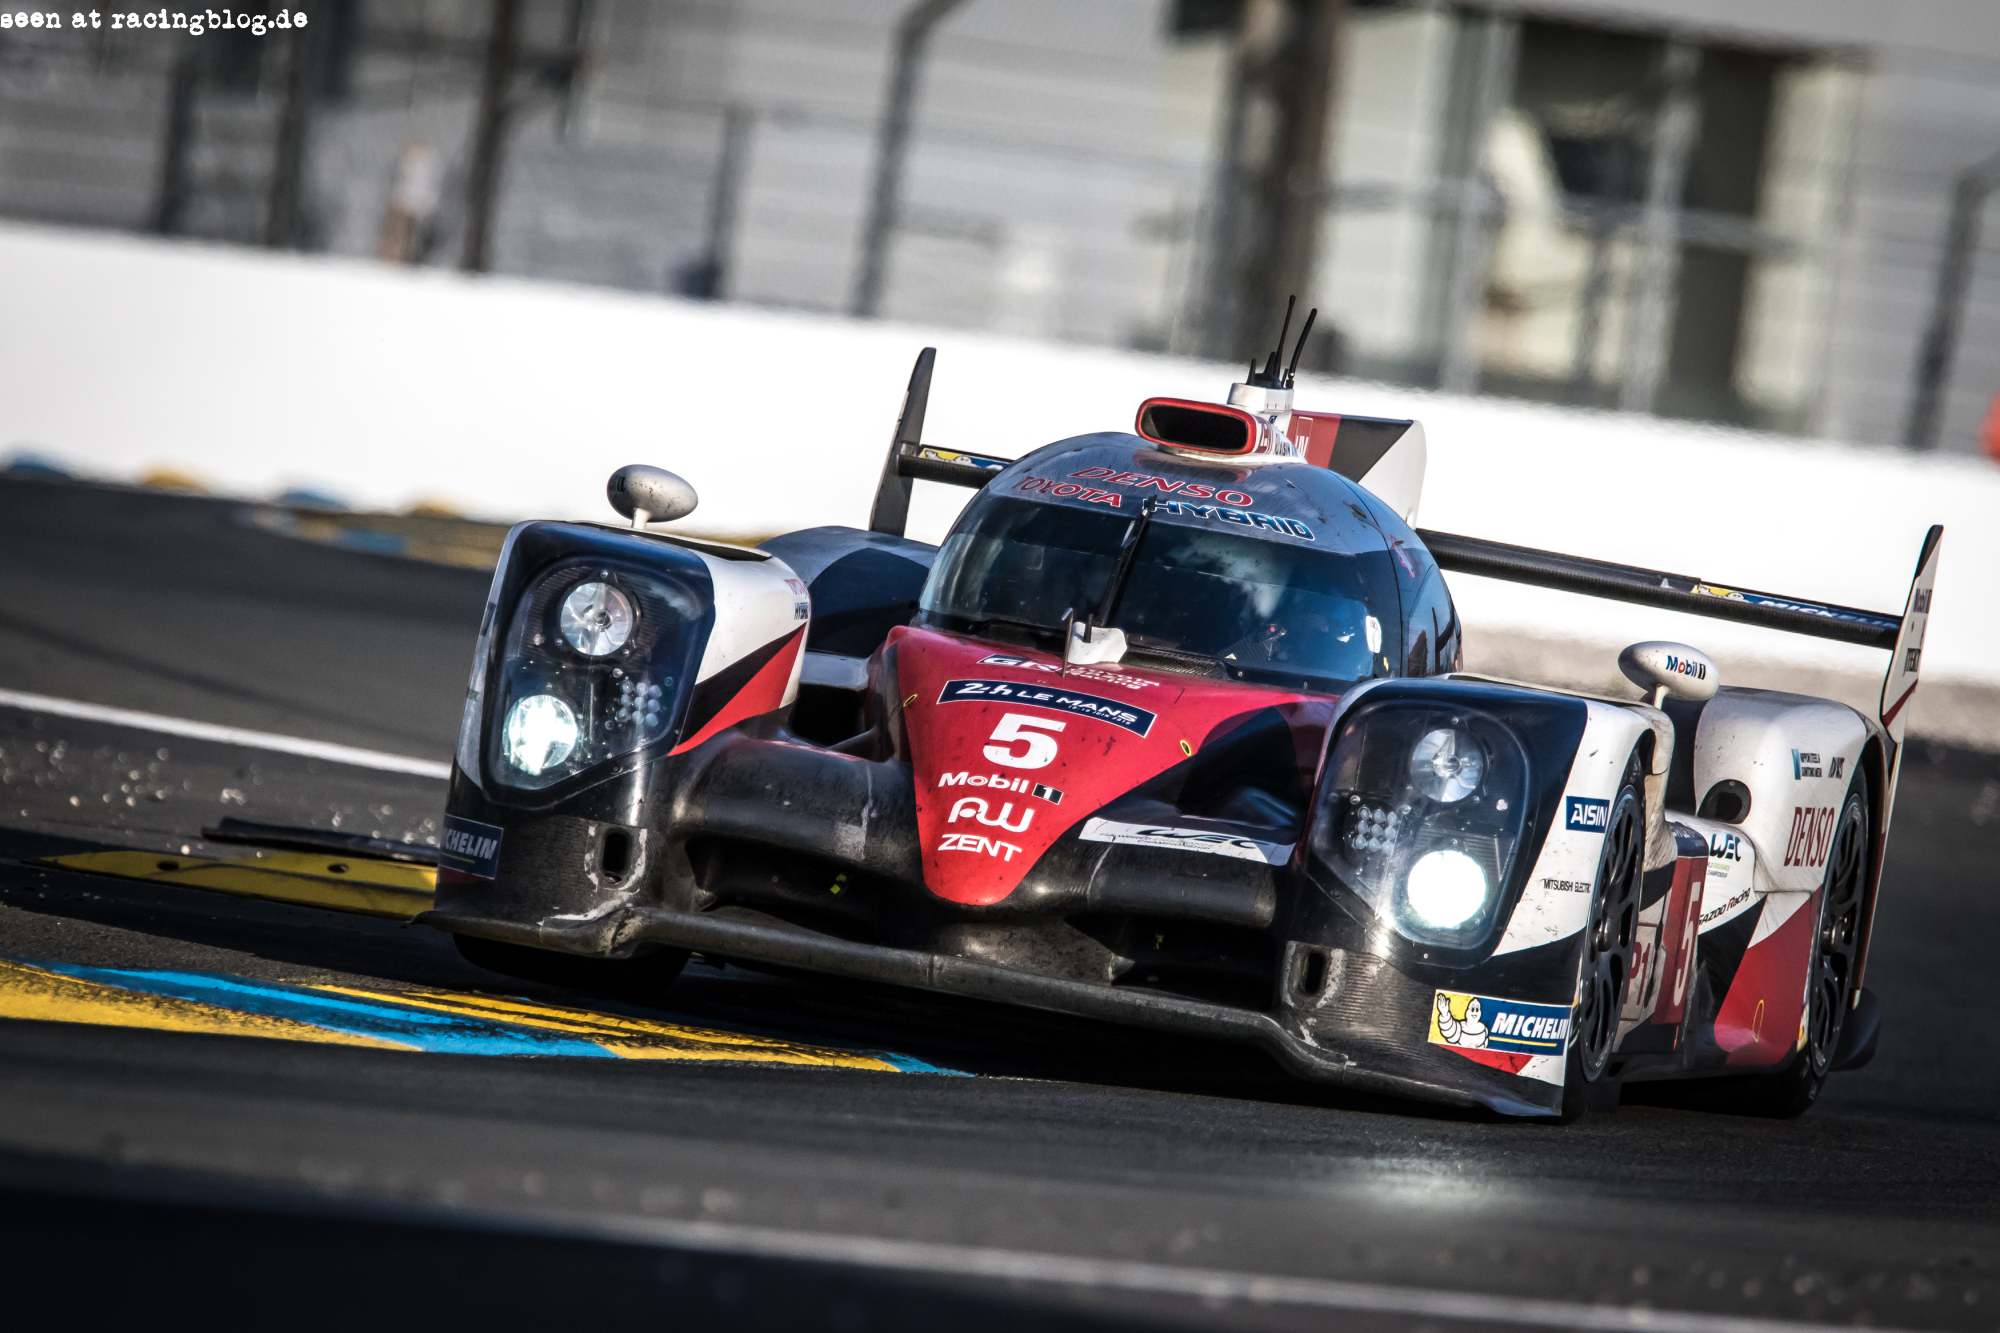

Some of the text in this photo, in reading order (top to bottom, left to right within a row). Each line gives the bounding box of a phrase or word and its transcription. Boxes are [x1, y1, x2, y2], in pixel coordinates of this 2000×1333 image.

[1013, 476, 1123, 508] TOYOTA
[1067, 467, 1254, 507] DENSO
[1142, 498, 1316, 541] HYBRID
[1665, 655, 1697, 678] Mobil
[1016, 691, 1054, 701] LE
[1056, 697, 1139, 724] MANS
[982, 712, 1067, 770] 5
[938, 771, 1030, 794] Mobil
[1571, 803, 1608, 827] AISIN
[937, 833, 1022, 862] ZENT
[1709, 833, 1741, 862] WEC
[1783, 806, 1835, 868] DENSO
[1491, 1012, 1569, 1040] MICHELIN
